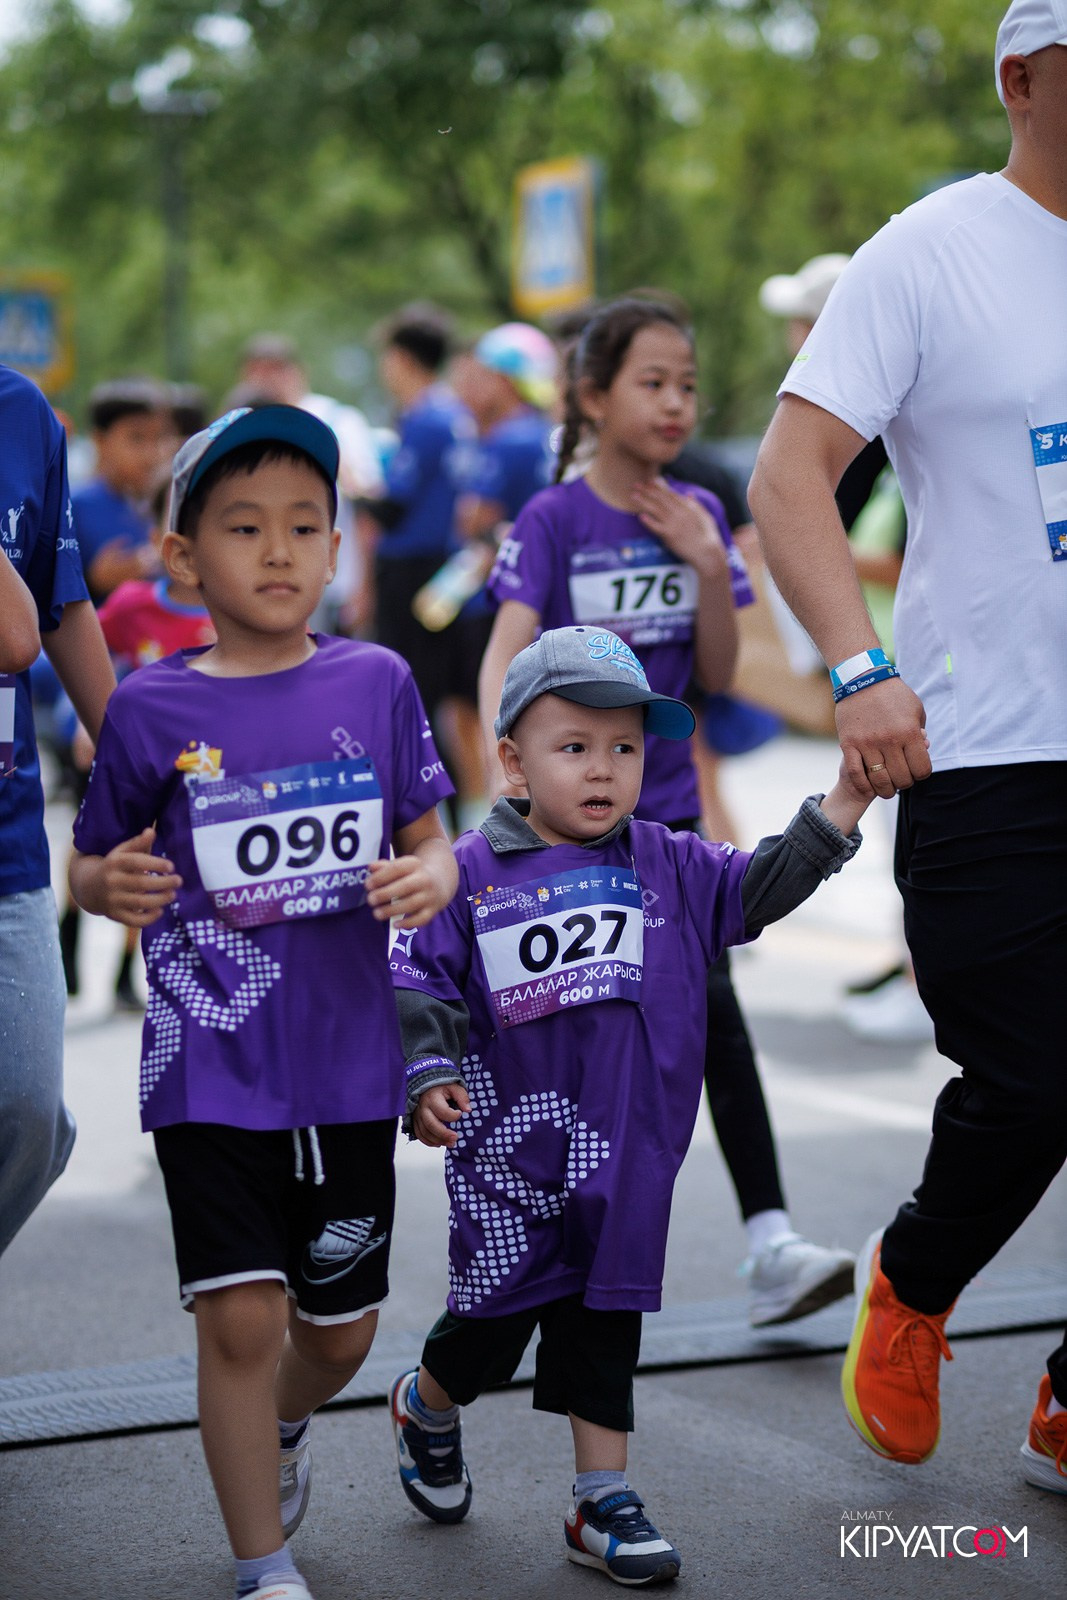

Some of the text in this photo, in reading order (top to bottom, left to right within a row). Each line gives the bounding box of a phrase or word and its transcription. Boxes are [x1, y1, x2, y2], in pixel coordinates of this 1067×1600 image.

[611, 571, 682, 612] 176
[236, 809, 361, 877] 096
[214, 871, 371, 908] БАЛАЛАР ЖАРЫС
[283, 896, 322, 916] 600
[489, 899, 517, 912] GROUP
[643, 917, 666, 928] OUP
[518, 910, 628, 974] 027
[401, 965, 428, 981] City
[500, 971, 577, 1007] БАЛАЛАР
[559, 985, 593, 1005] 600
